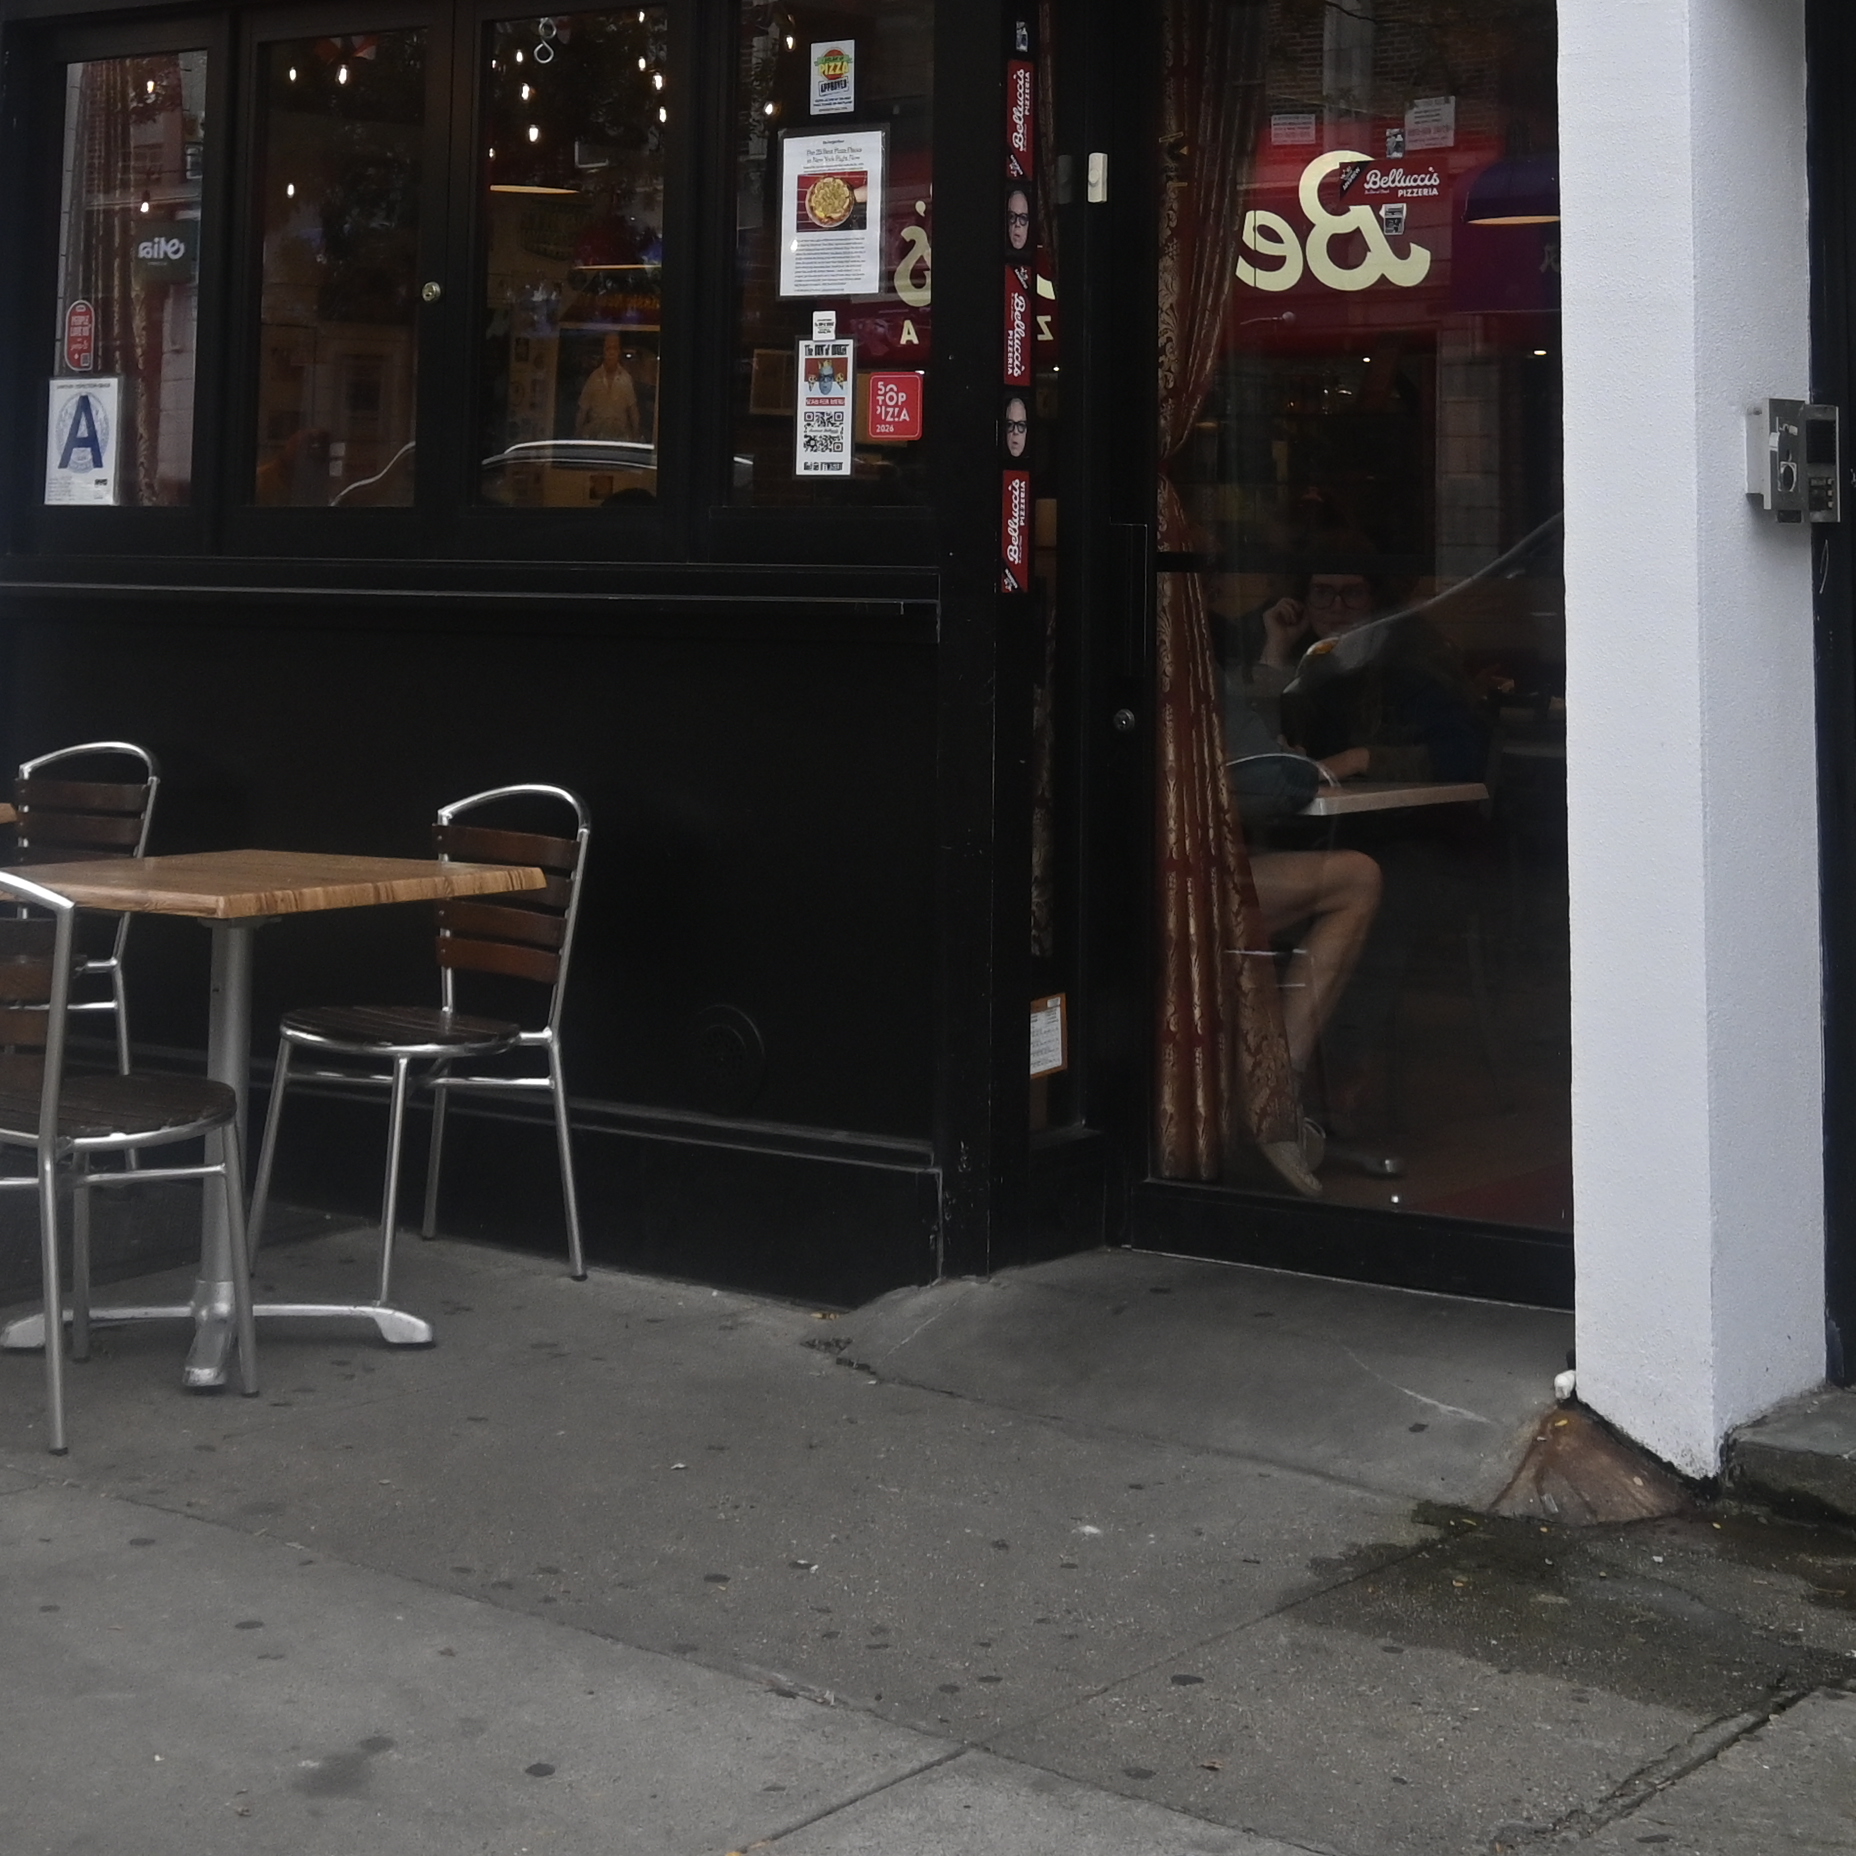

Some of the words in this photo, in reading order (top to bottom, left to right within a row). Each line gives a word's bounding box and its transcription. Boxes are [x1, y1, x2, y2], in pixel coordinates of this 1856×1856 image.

[1012, 69, 1026, 152] Bellucci's
[1364, 166, 1440, 189] Bellucci's
[1398, 187, 1439, 198] PIZZERIA
[1012, 292, 1026, 378] Bellucci's
[58, 395, 103, 469] A
[877, 392, 906, 405] TOP
[1006, 478, 1020, 565] Bellucci's
